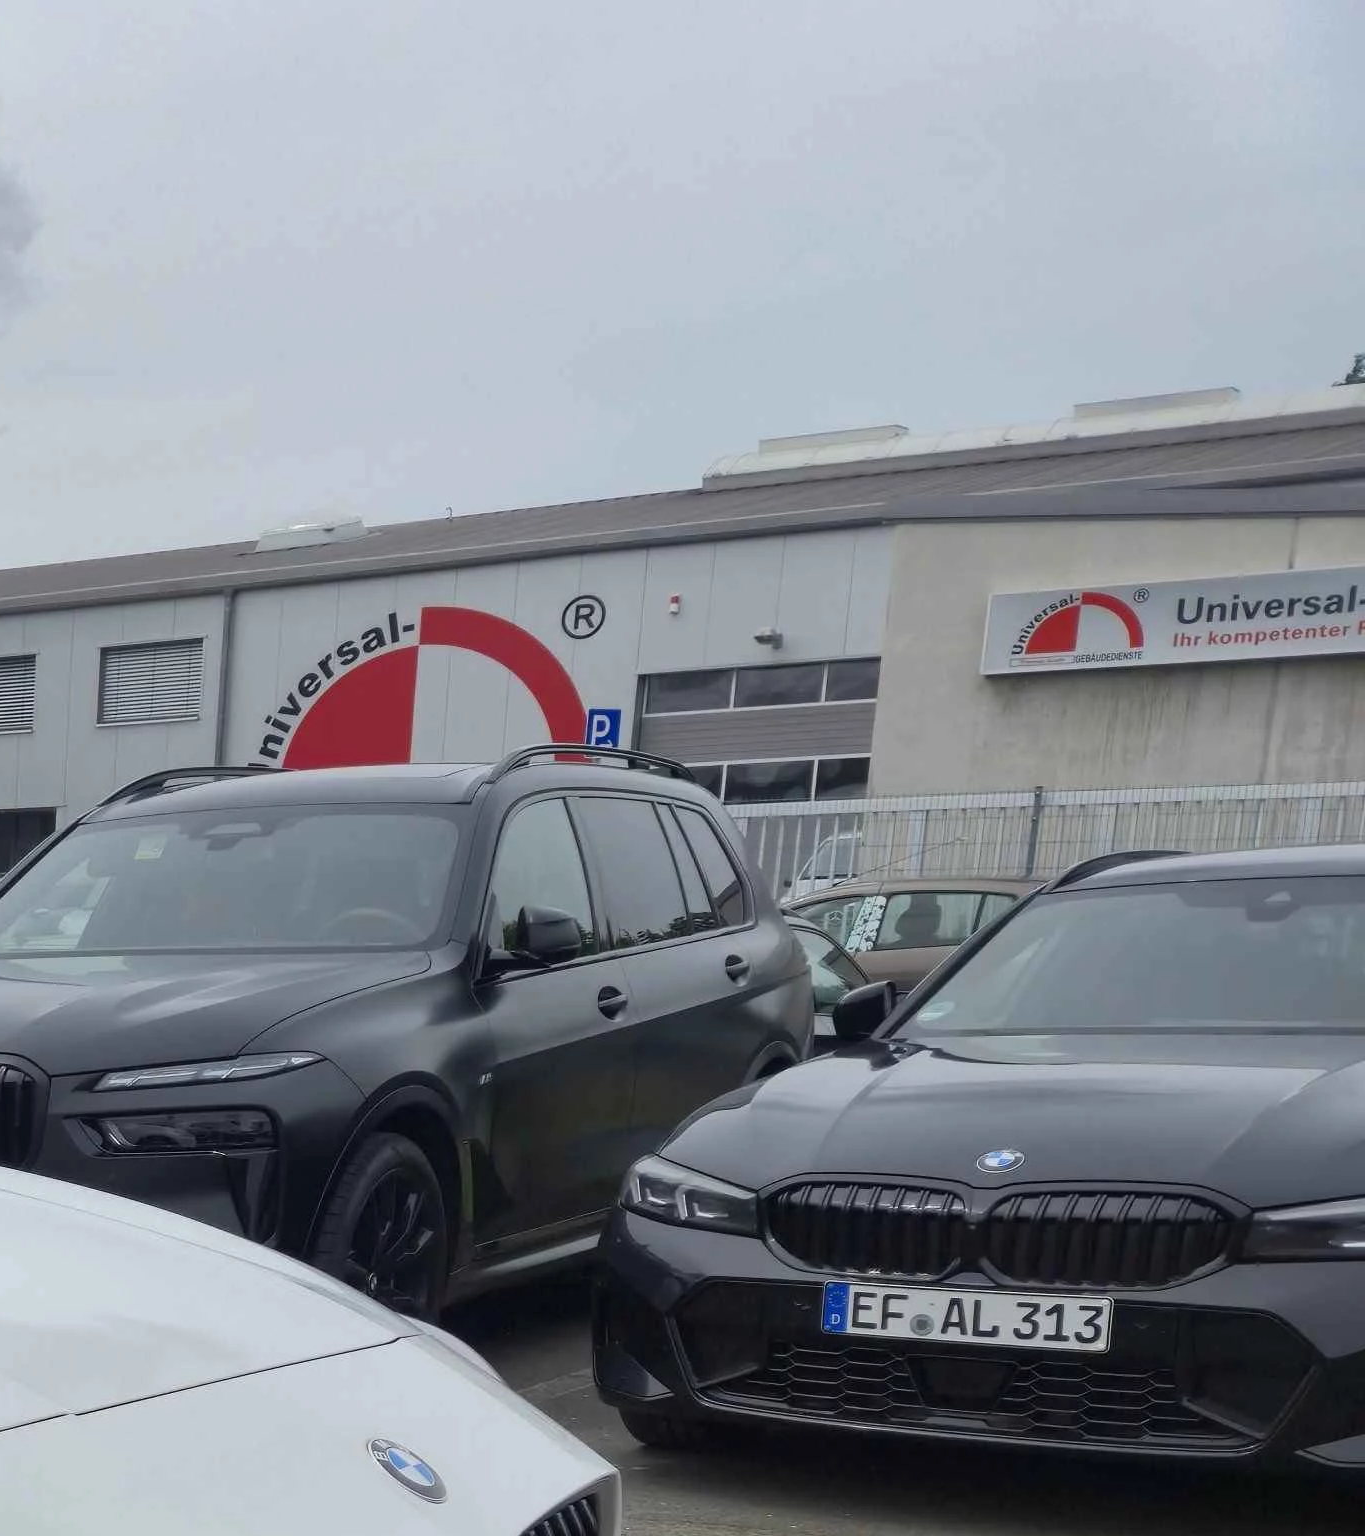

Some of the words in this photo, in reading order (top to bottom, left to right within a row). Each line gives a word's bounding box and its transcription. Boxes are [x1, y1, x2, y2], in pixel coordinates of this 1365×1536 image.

[1011, 593, 1081, 655] Universal-
[1177, 585, 1365, 625] Universal-
[1173, 632, 1201, 648] Ihr
[1207, 623, 1352, 646] kompetenter
[248, 612, 415, 767] niversal-
[592, 714, 611, 747] P
[831, 1313, 841, 1325] D
[851, 1291, 910, 1331] EF
[940, 1297, 1000, 1338] AL
[1013, 1301, 1104, 1345] 313
